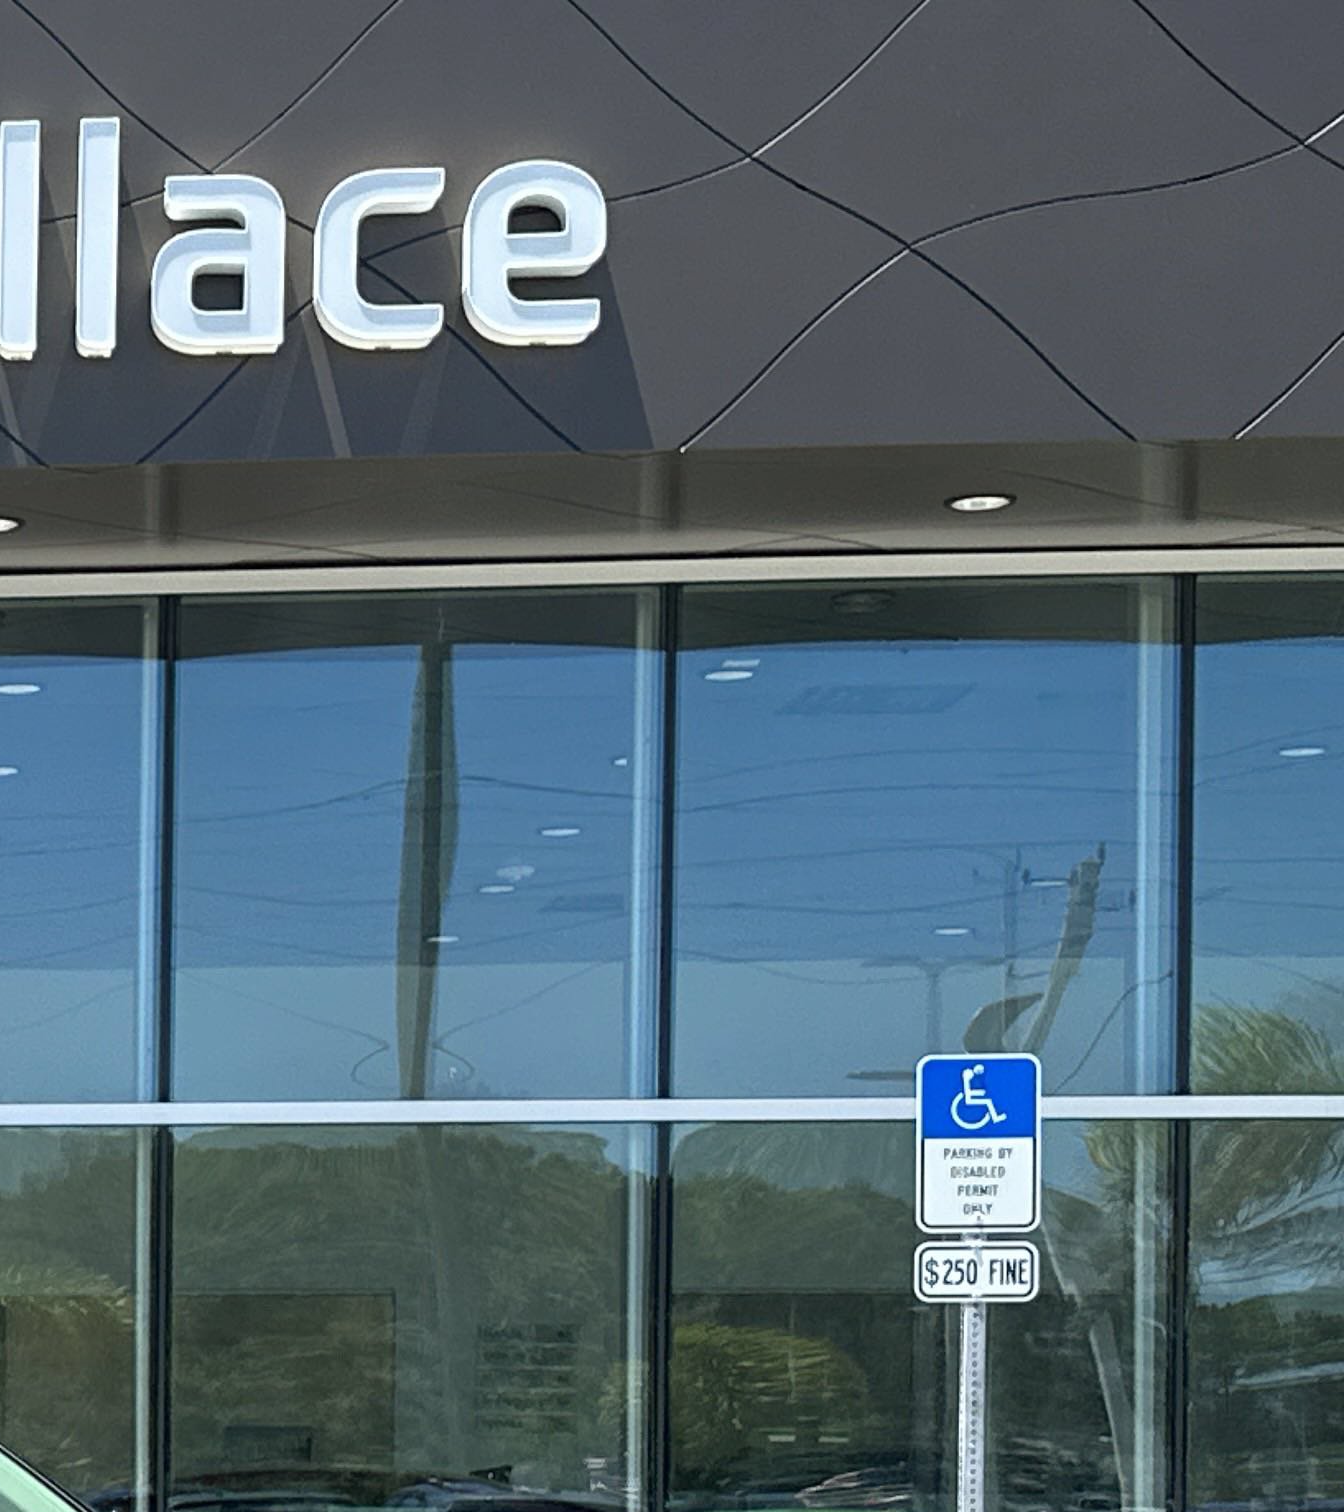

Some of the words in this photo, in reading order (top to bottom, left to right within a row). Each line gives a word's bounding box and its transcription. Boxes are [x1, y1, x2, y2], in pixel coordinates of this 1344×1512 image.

[943, 1148, 993, 1160] PARKING
[998, 1148, 1013, 1159] BY
[950, 1166, 1006, 1178] DISABLED
[957, 1184, 999, 1197] PERMIT
[963, 1203, 993, 1216] ONLY
[924, 1257, 978, 1287] $250
[989, 1258, 1028, 1285] FINE
